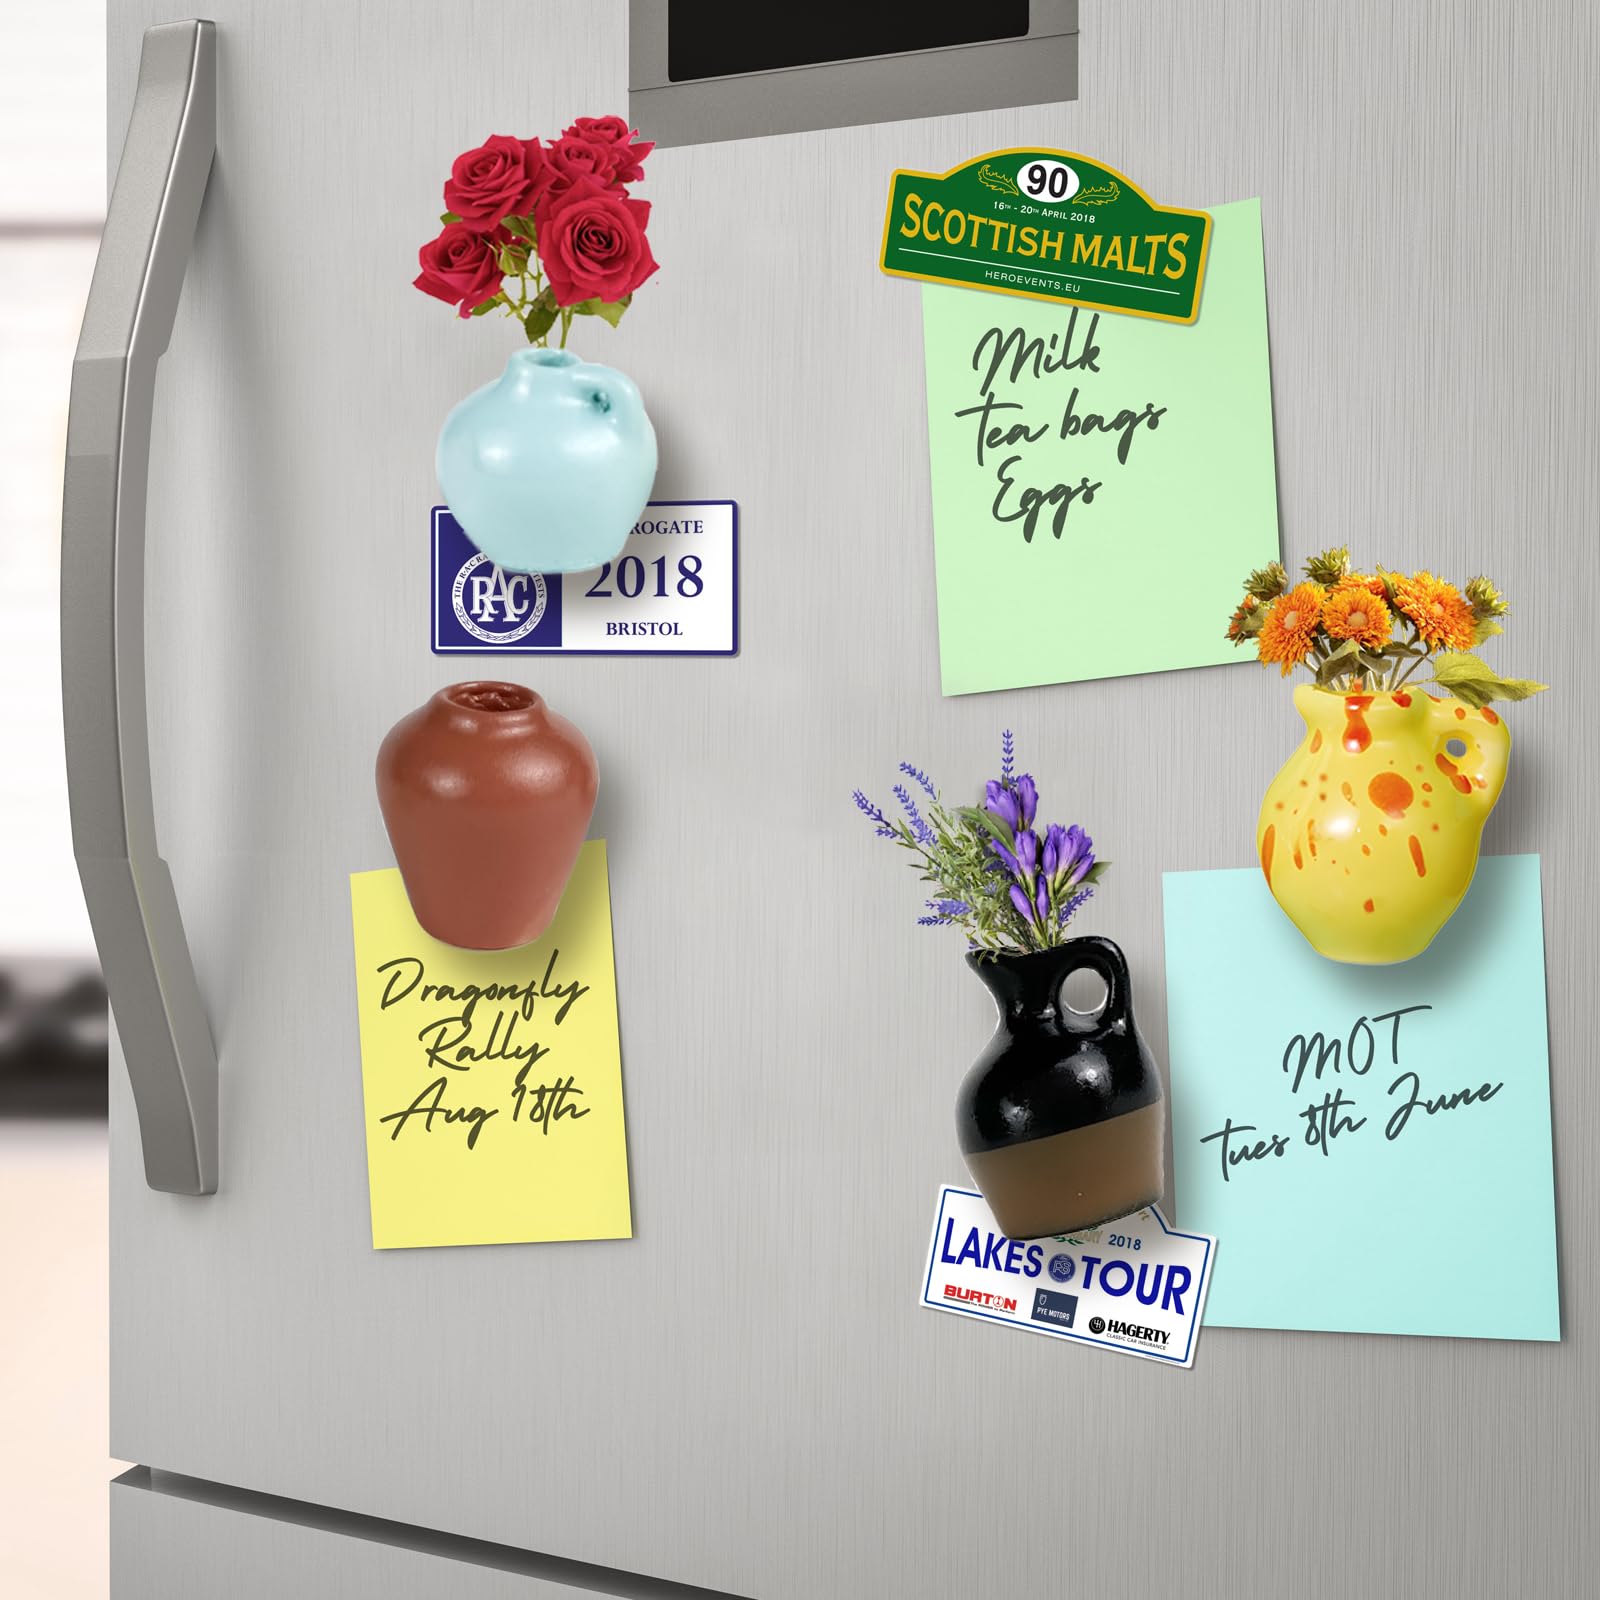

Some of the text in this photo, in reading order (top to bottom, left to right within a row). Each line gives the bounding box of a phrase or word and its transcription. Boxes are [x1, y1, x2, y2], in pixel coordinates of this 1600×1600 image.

[1026, 164, 1069, 199] 90
[899, 192, 1191, 280] SCOTTISH MALTS
[1041, 208, 1068, 220] APRIL
[1070, 212, 1096, 224] 2018
[984, 270, 1081, 293] HEROEVENTS.EU
[972, 306, 1101, 397] Milk
[1060, 387, 1168, 466] bags
[992, 455, 1103, 544] Eggs
[470, 564, 530, 623] RAC
[584, 554, 704, 598] 2018
[606, 621, 684, 636] BRISTOL
[376, 948, 590, 1028] Dragonfly
[418, 1010, 551, 1087] Rally
[1282, 1004, 1433, 1094] MOT
[380, 1076, 591, 1150] Aug 18th
[1299, 1088, 1368, 1157] 8th
[1385, 1071, 1504, 1141] June
[940, 1216, 1192, 1316] LAKES TOUR
[1108, 1233, 1142, 1251] 2018
[943, 1283, 1018, 1311] BURTON
[1036, 1306, 1071, 1321] PYE MOTORS
[1106, 1332, 1126, 1342] CLASSIC
[1138, 1339, 1167, 1351] INSURANCE
[1107, 1318, 1171, 1345] HAGERTY
